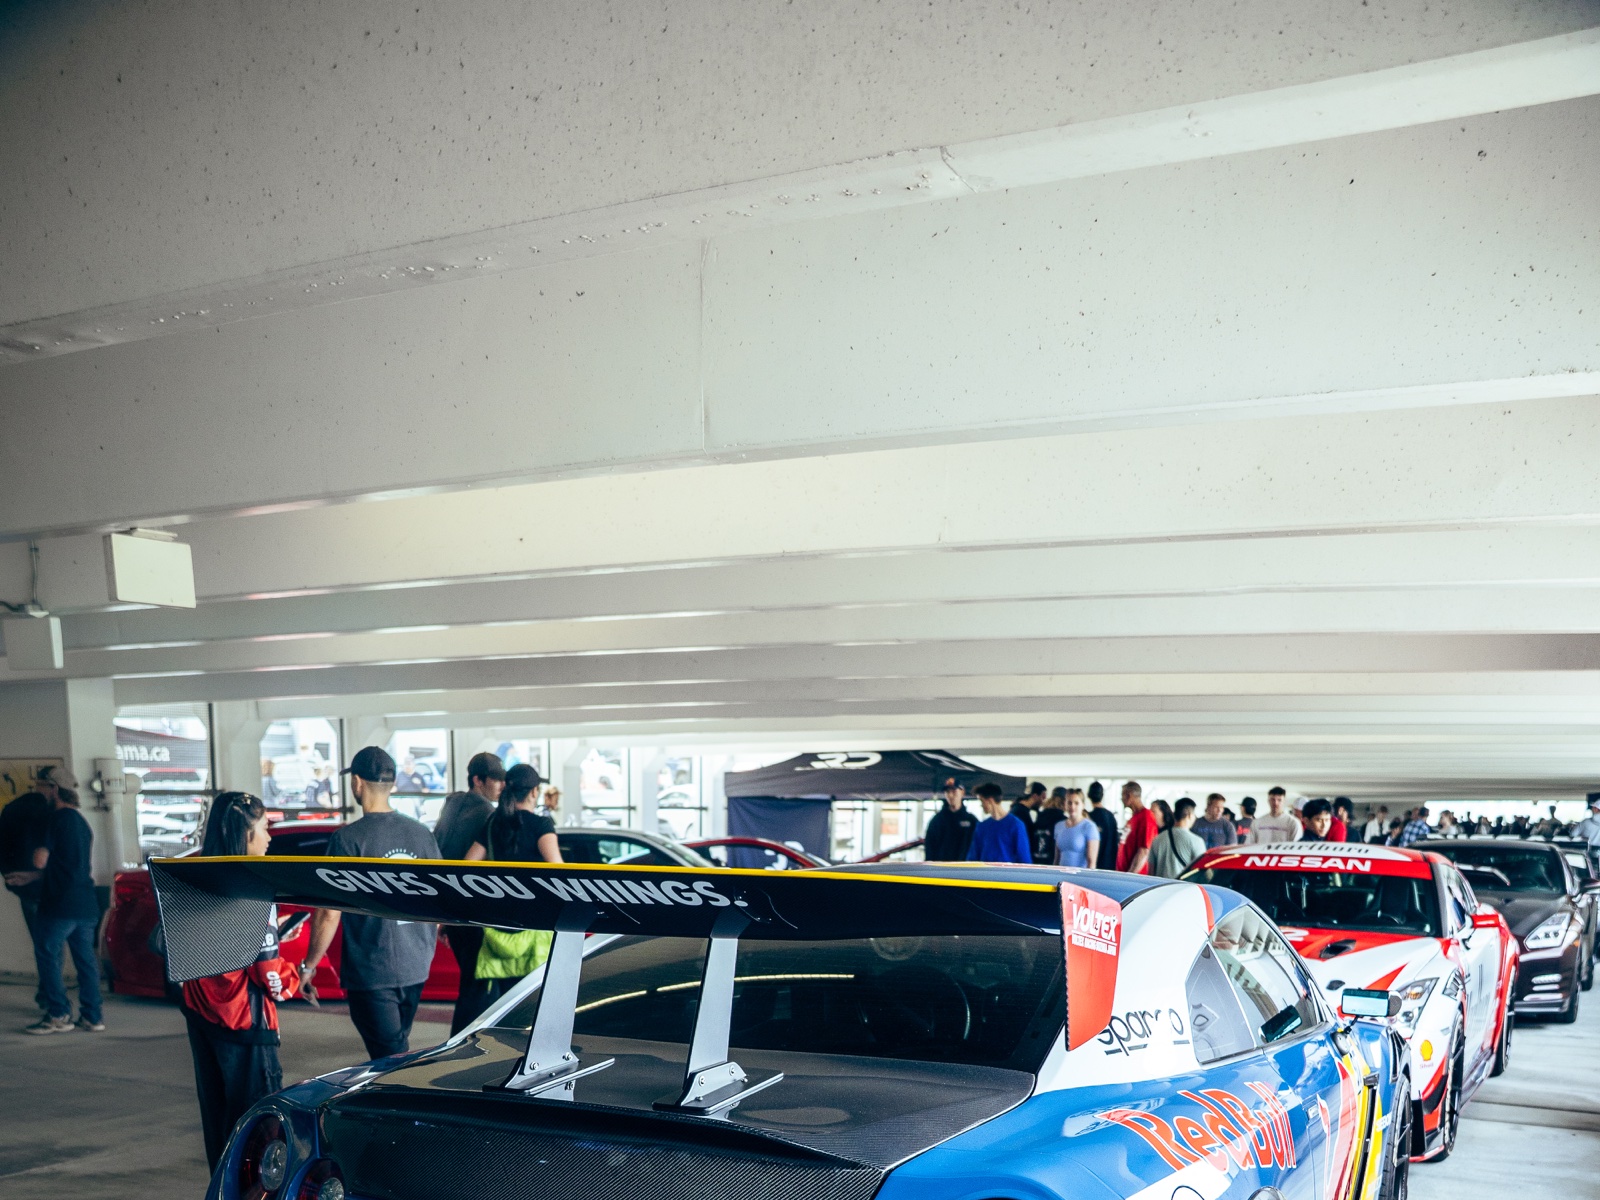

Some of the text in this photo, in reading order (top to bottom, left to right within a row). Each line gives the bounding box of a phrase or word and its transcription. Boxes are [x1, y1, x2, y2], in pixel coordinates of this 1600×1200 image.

[1244, 856, 1371, 872] NISSAN
[315, 867, 439, 896] GIVES
[428, 873, 536, 900] YOU
[1072, 903, 1118, 942] VOLTEX
